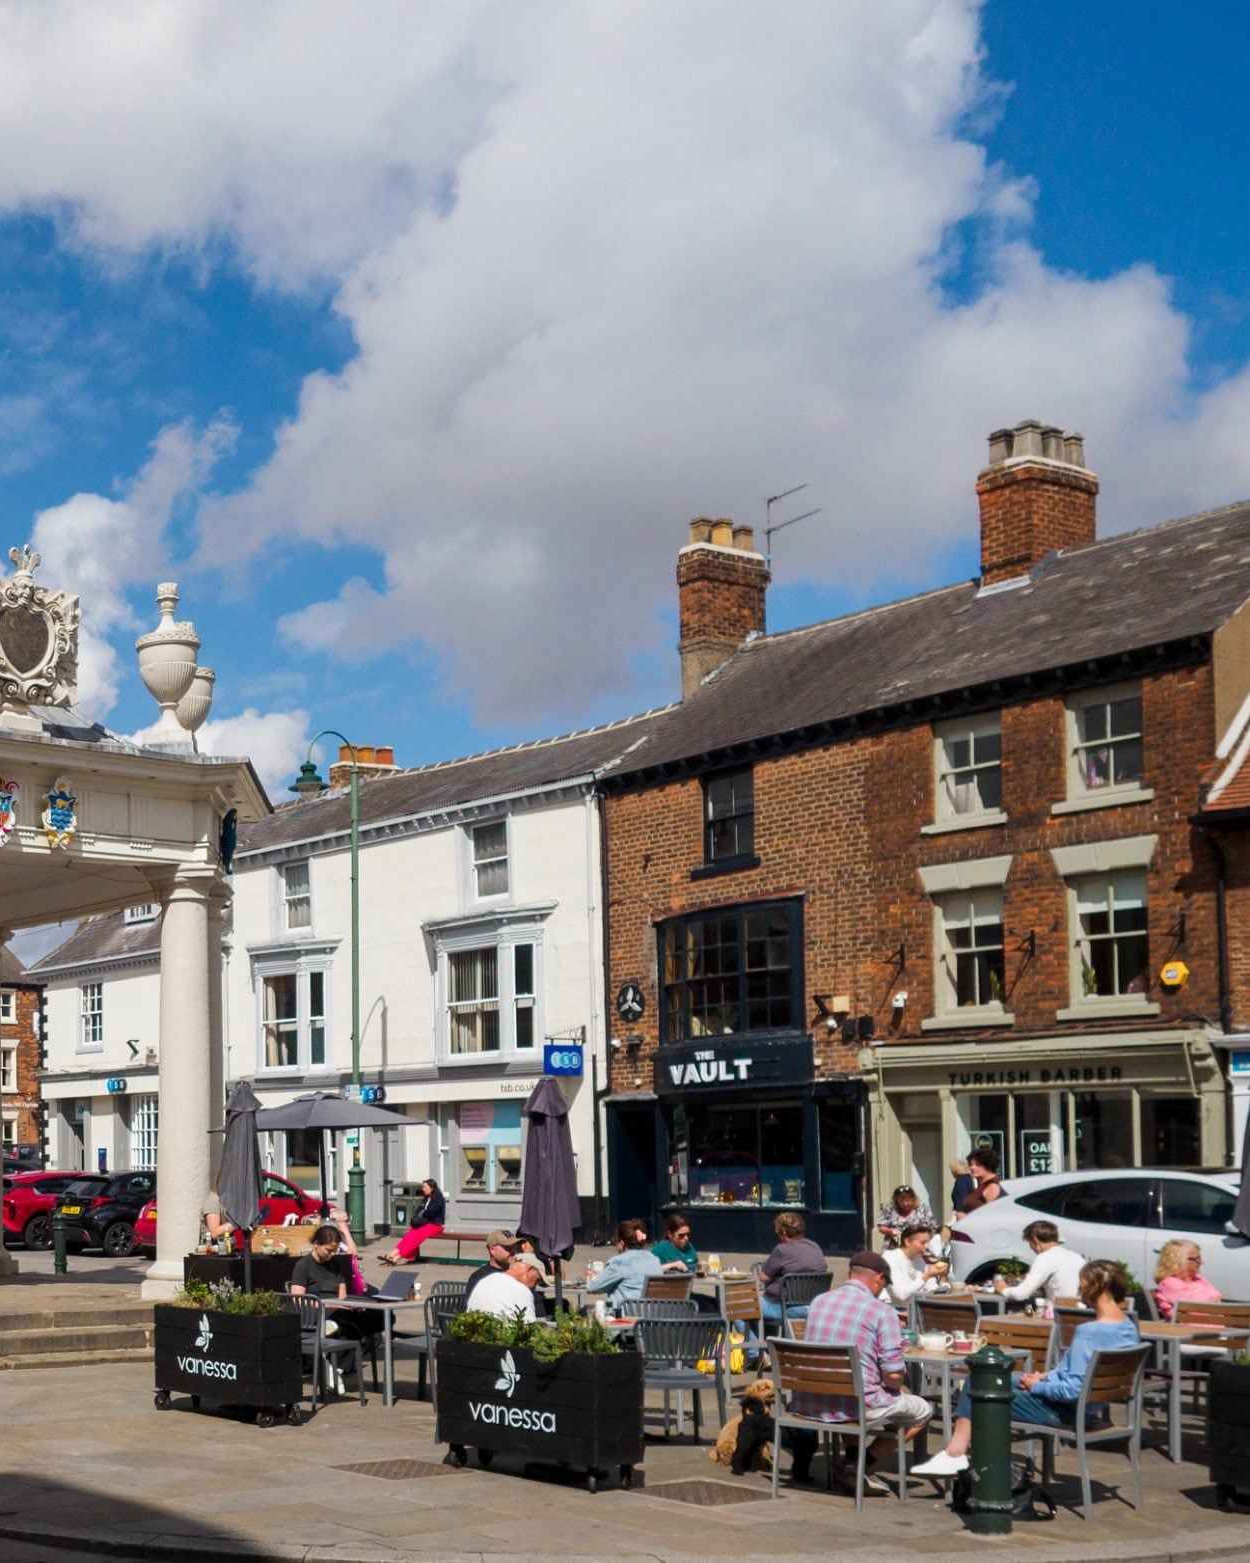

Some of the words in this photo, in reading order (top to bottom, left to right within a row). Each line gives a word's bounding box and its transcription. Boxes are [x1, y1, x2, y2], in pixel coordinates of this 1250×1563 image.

[694, 1050, 715, 1061] THE
[669, 1058, 753, 1085] VAULT
[948, 1070, 1031, 1087] TURKISH
[1040, 1066, 1123, 1083] BARBER
[176, 1355, 237, 1380] vanessa
[469, 1401, 556, 1432] vanessa
